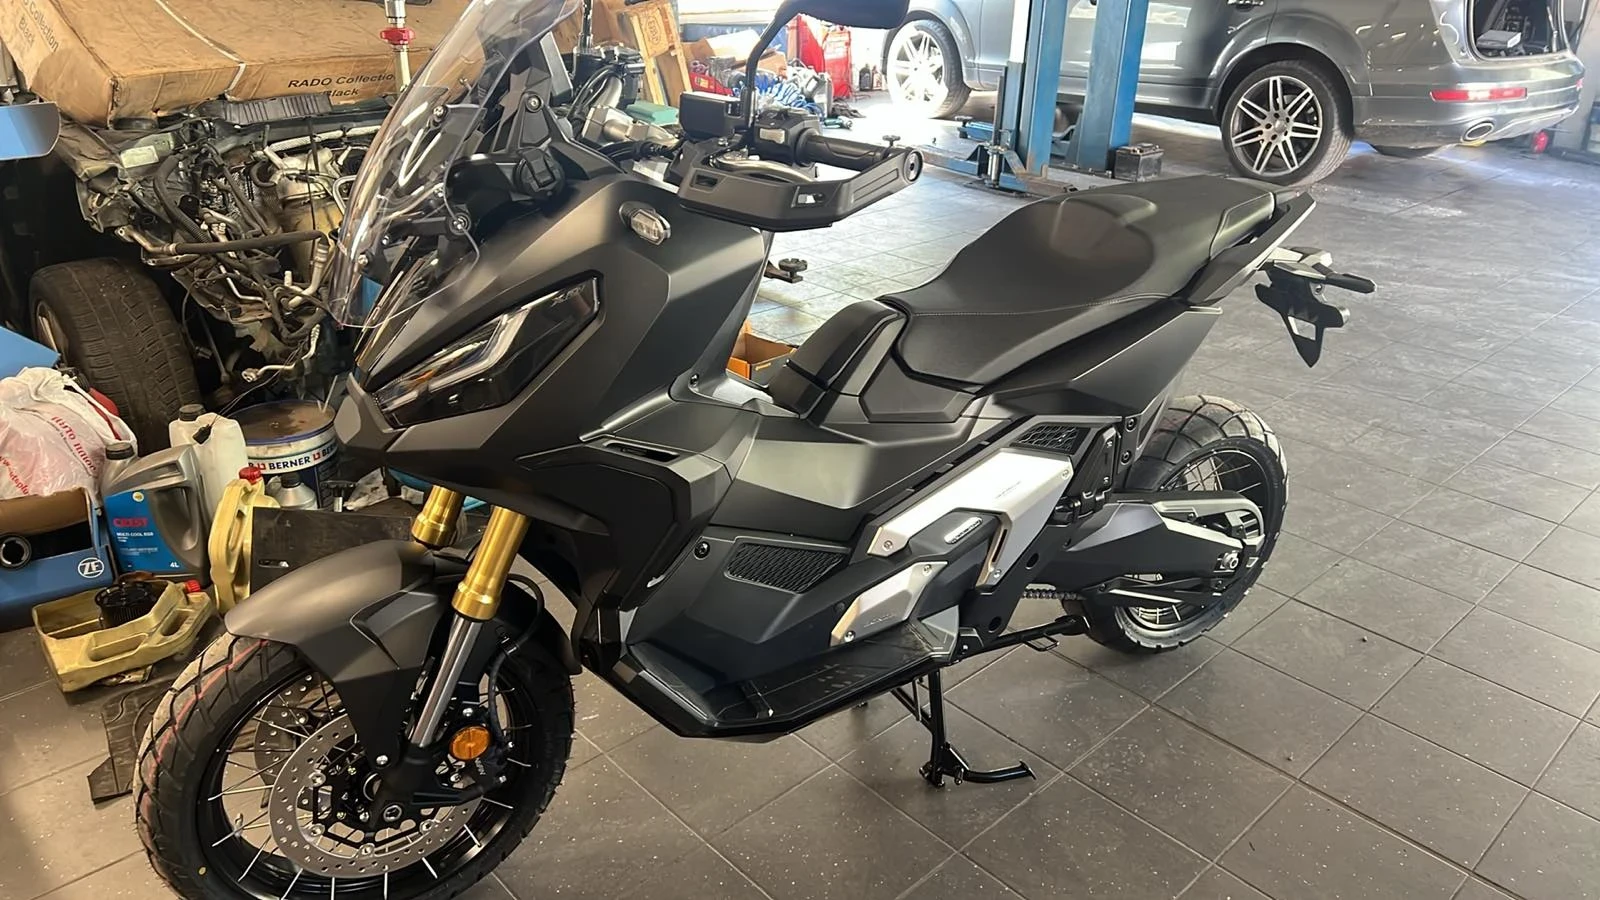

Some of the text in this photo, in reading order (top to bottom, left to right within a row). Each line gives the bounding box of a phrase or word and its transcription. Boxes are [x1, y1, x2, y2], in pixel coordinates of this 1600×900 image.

[30, 1, 59, 52] Collection
[287, 73, 396, 88] RADO Collectio
[268, 456, 311, 470] BERNER
[82, 561, 100, 575] ZF
